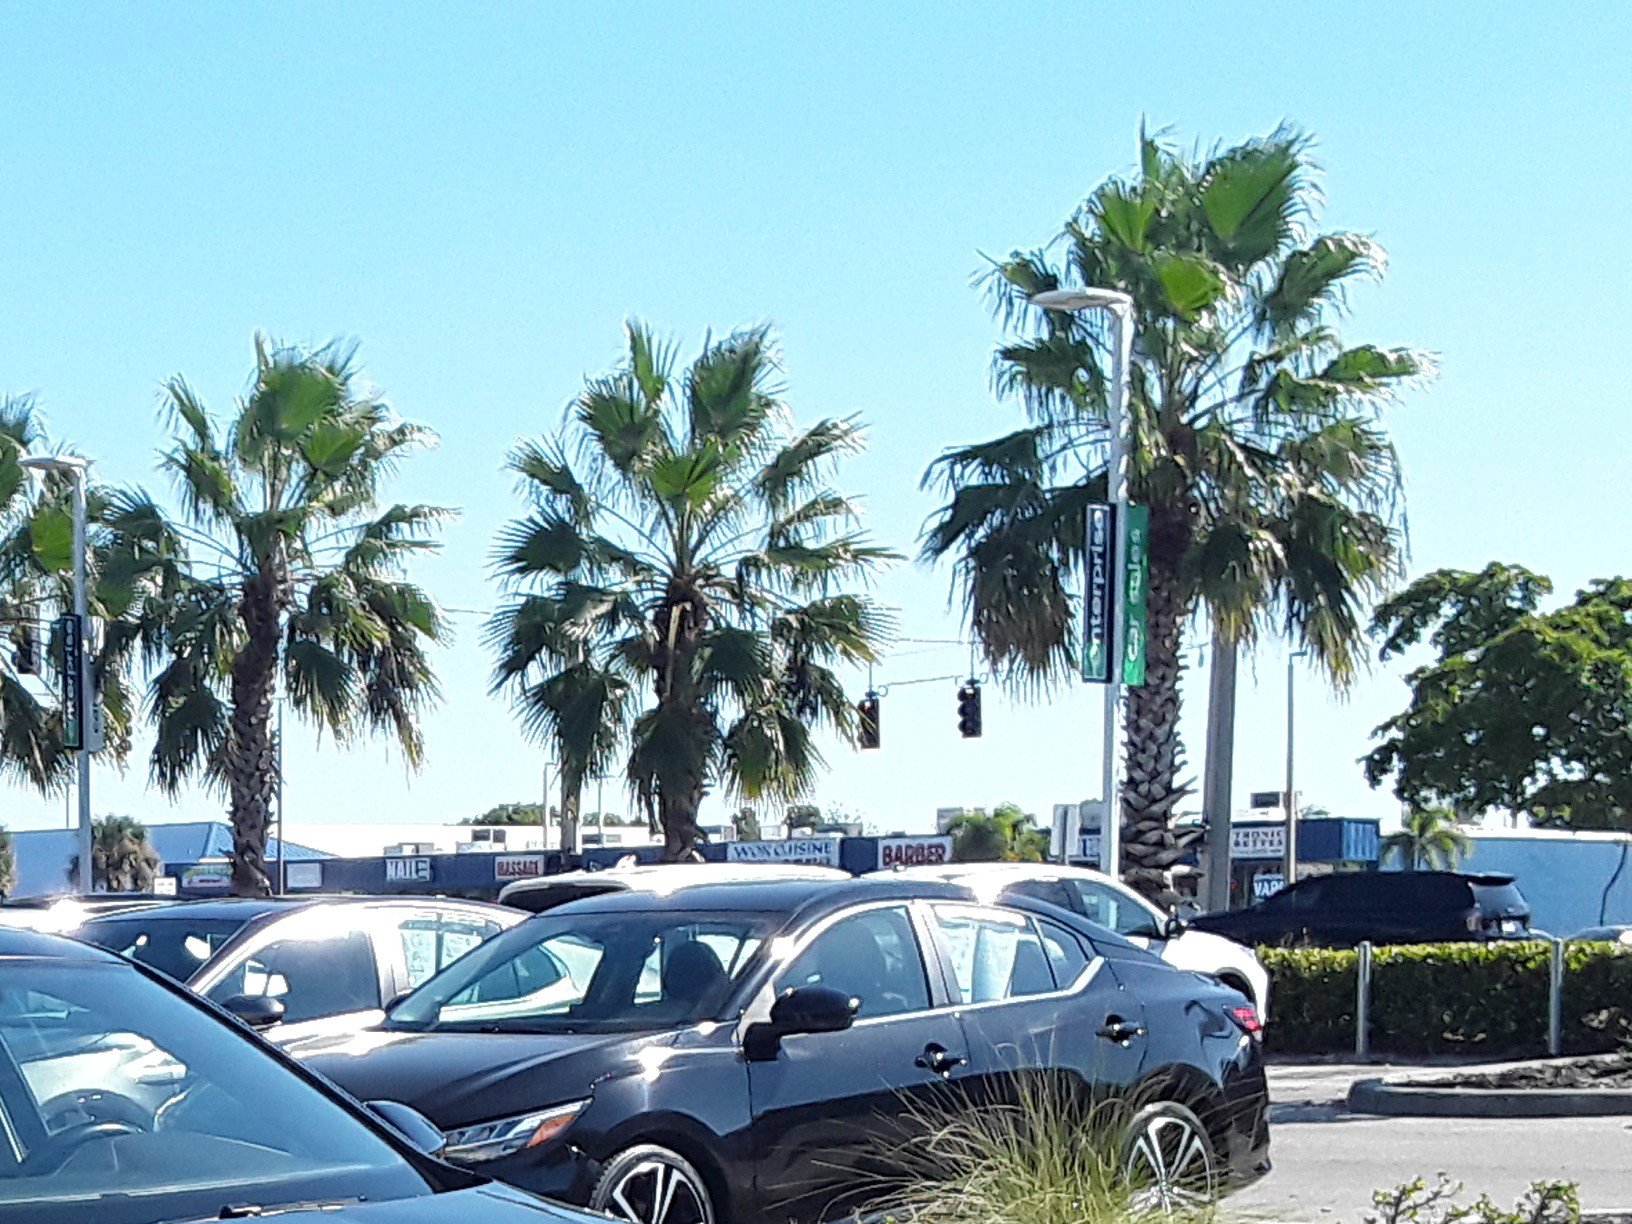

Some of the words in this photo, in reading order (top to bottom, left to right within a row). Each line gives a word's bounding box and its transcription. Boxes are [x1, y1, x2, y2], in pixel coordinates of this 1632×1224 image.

[1090, 510, 1105, 671] enterprise
[1128, 528, 1142, 605] sales
[1127, 618, 1141, 662] car
[883, 843, 946, 866] BARBER
